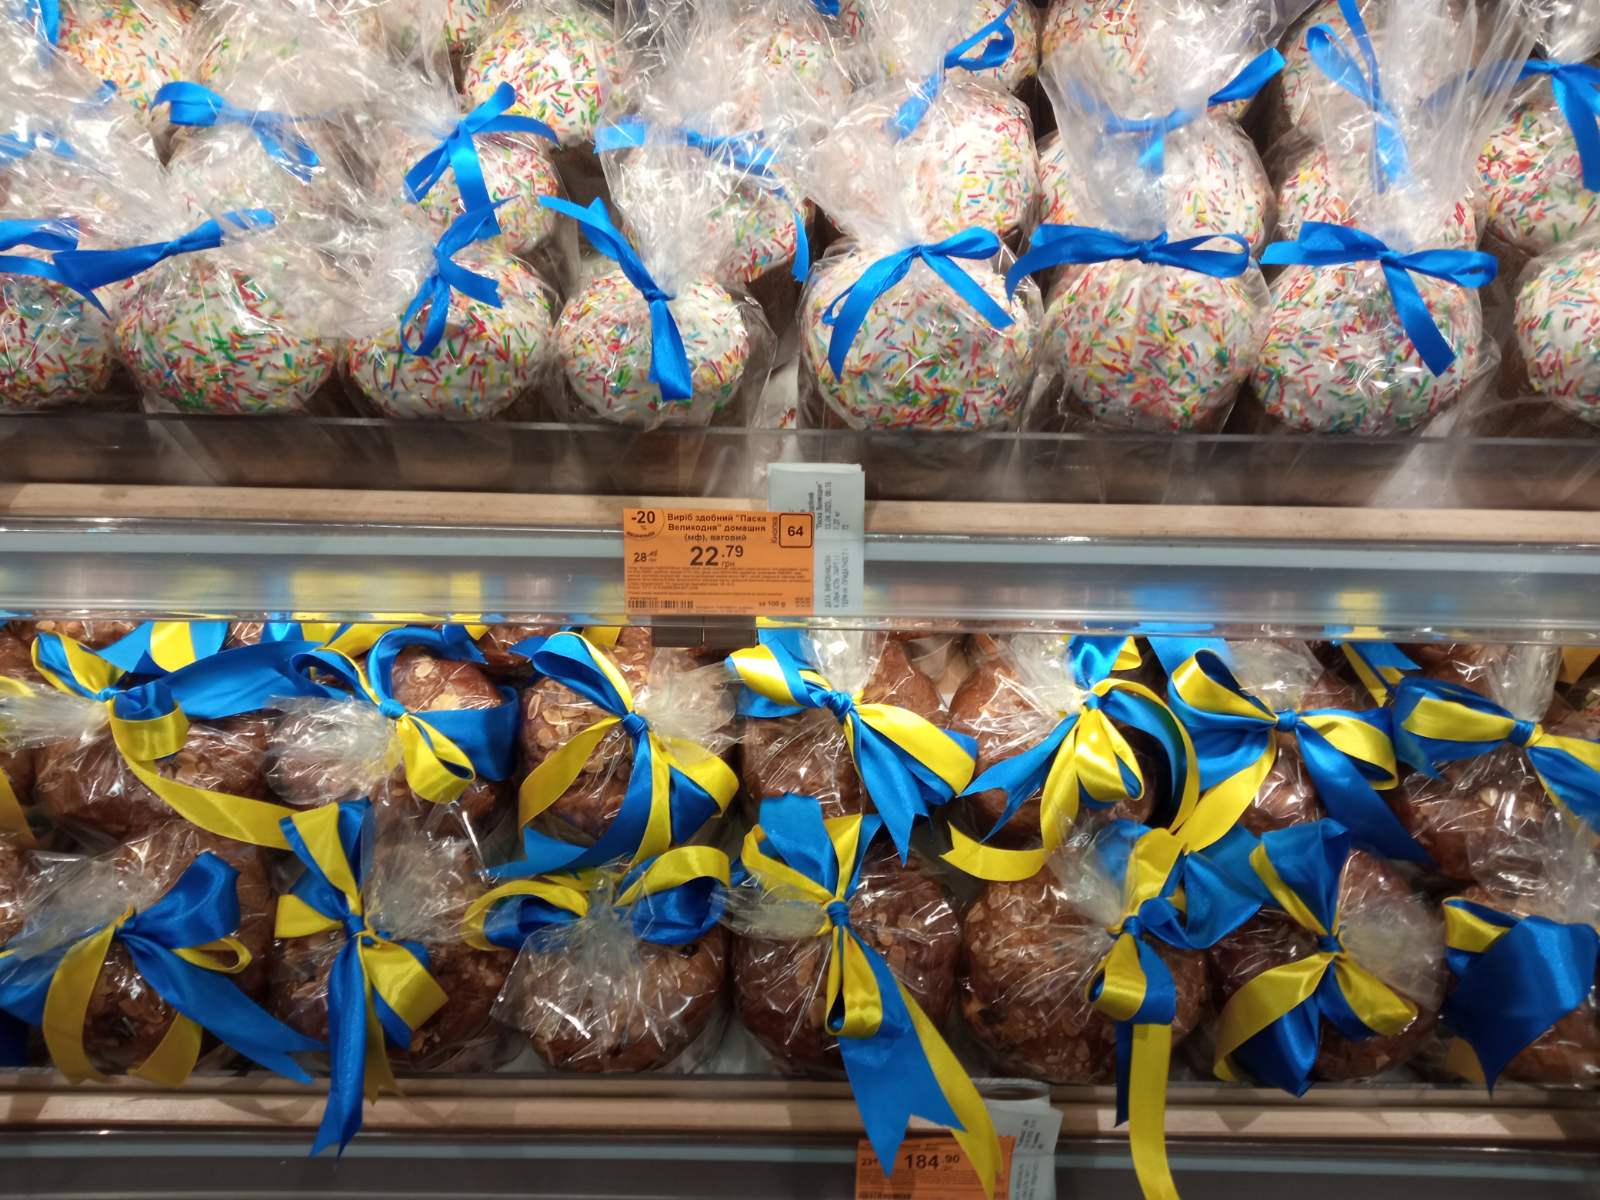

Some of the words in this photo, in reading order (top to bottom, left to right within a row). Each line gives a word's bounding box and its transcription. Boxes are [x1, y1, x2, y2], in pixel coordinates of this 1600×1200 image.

[631, 510, 655, 524] -20
[667, 513, 693, 523] Виріб
[695, 514, 734, 523] здобний
[735, 514, 767, 523] "Паска
[668, 523, 722, 532] Великодня"
[724, 525, 767, 534] домашня
[787, 525, 804, 537] 64
[684, 534, 707, 543] (мф),
